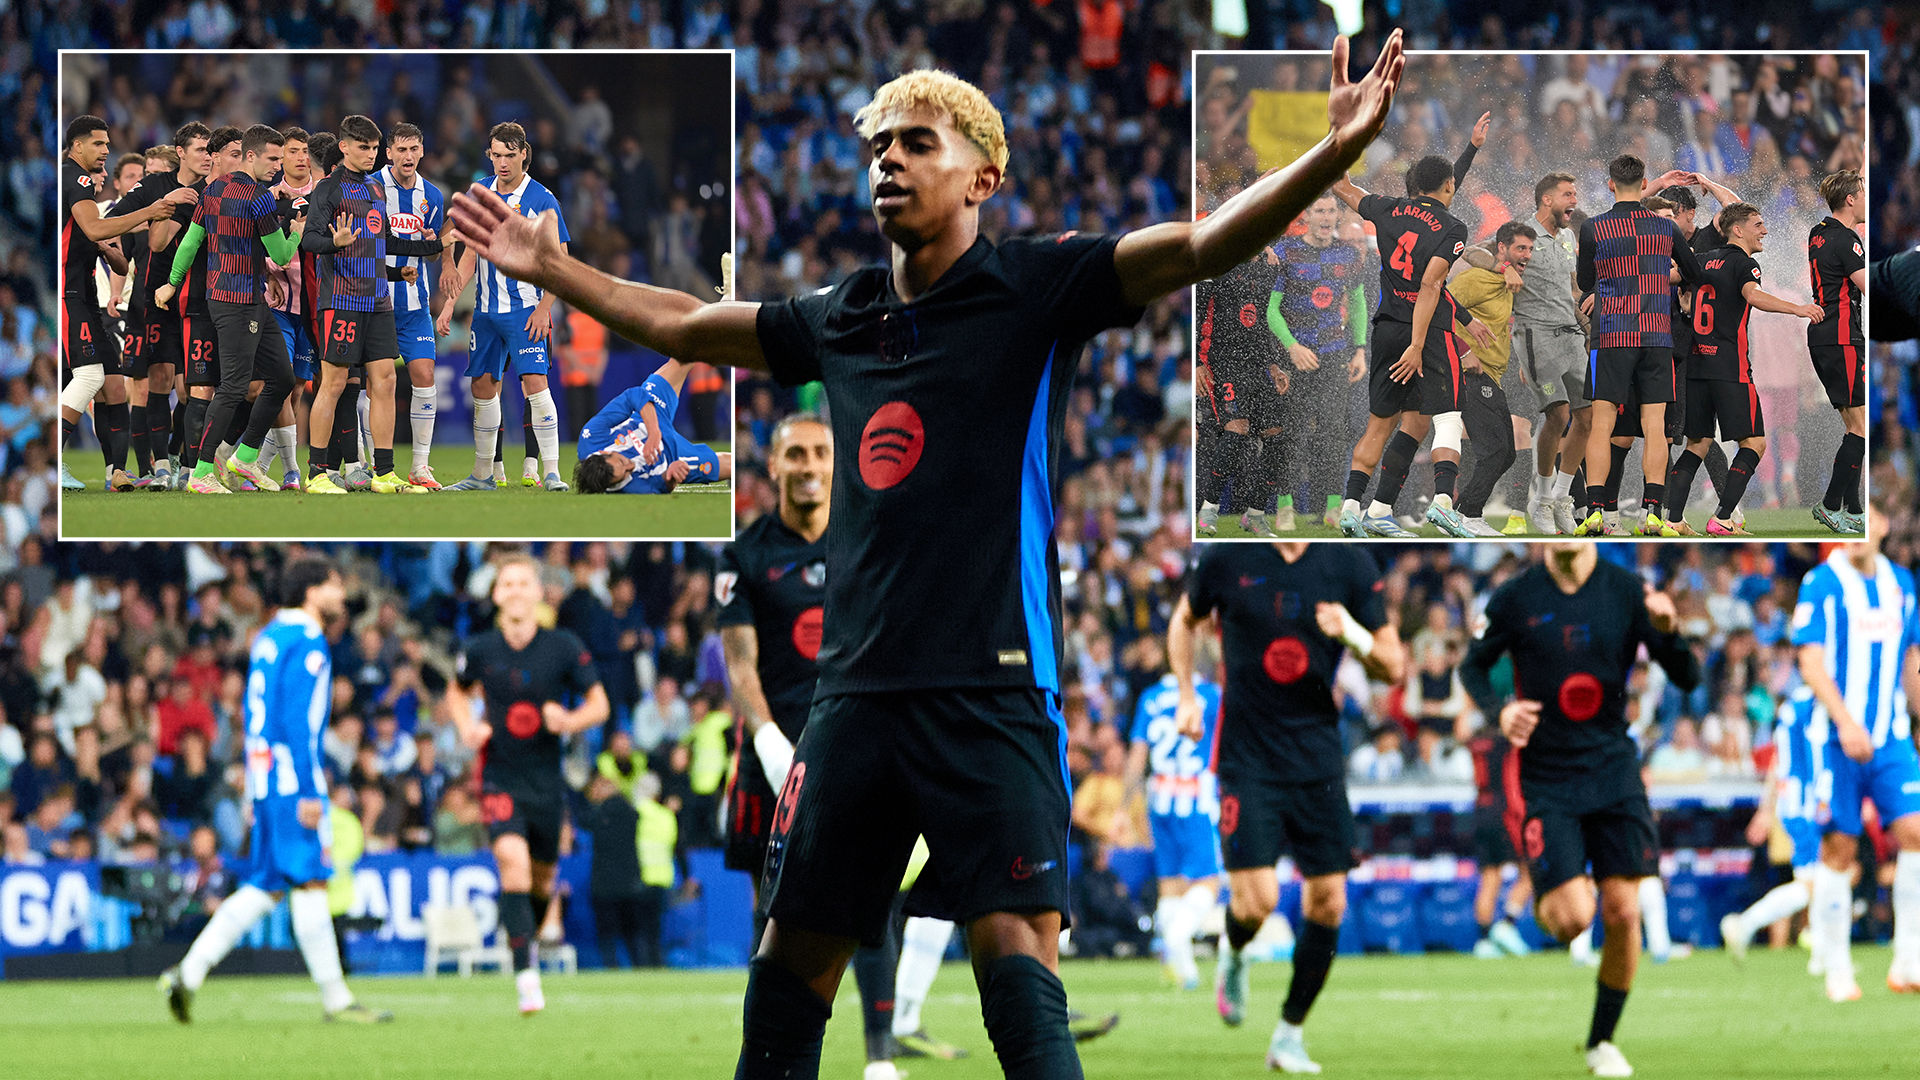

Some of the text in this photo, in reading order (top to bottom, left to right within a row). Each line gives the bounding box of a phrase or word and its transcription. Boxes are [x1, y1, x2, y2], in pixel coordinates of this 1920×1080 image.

[1403, 205, 1442, 232] ARAUJO
[1389, 230, 1419, 281] 4
[1705, 259, 1726, 270] GAVI
[1693, 284, 1716, 335] 6
[80, 322, 92, 342] 4
[145, 323, 161, 344] 15
[333, 319, 356, 343] 35
[124, 334, 143, 356] 21
[191, 339, 213, 361] 32
[1222, 382, 1235, 401] 3
[735, 789, 761, 836] 11
